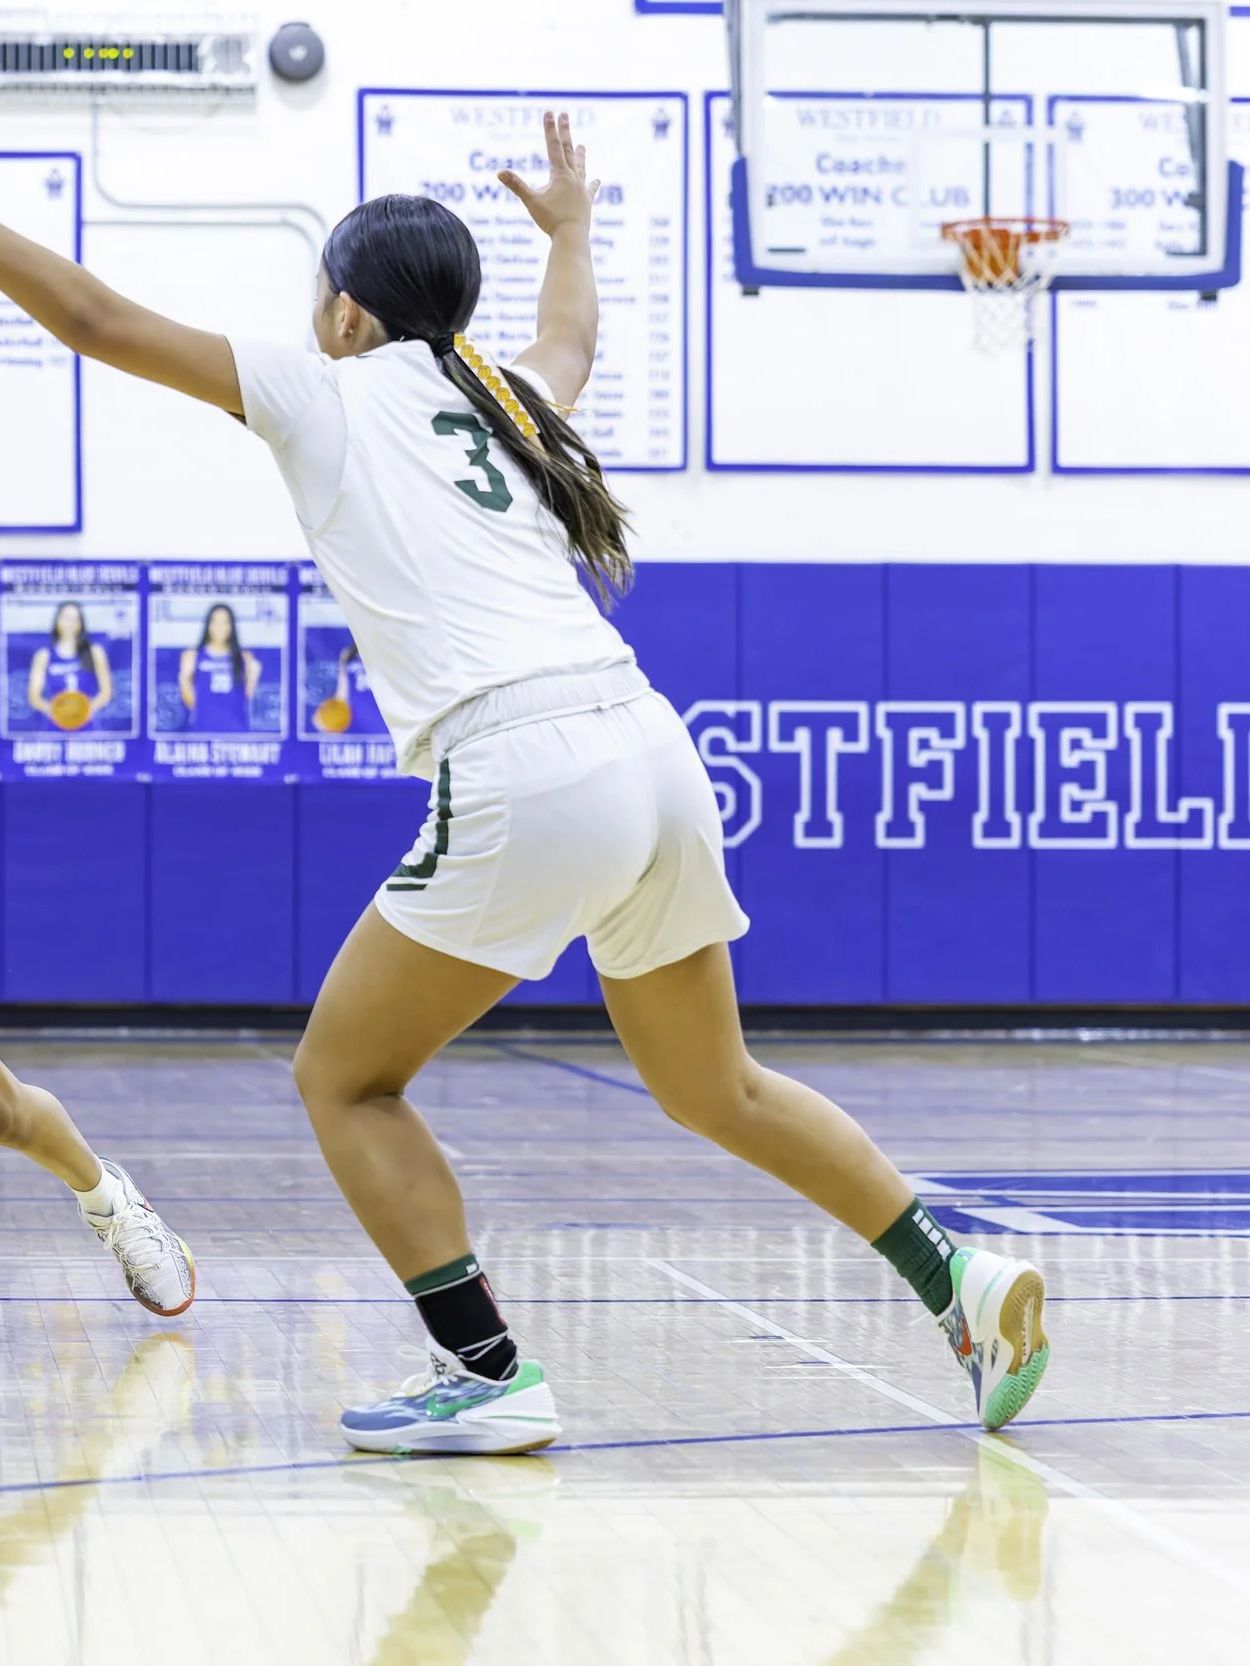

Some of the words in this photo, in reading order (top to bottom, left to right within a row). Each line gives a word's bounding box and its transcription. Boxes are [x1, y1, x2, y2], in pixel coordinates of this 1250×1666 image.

[469, 151, 550, 172] Coach
[816, 152, 906, 173] Coache
[819, 185, 882, 204] WIN
[431, 410, 513, 513] 3
